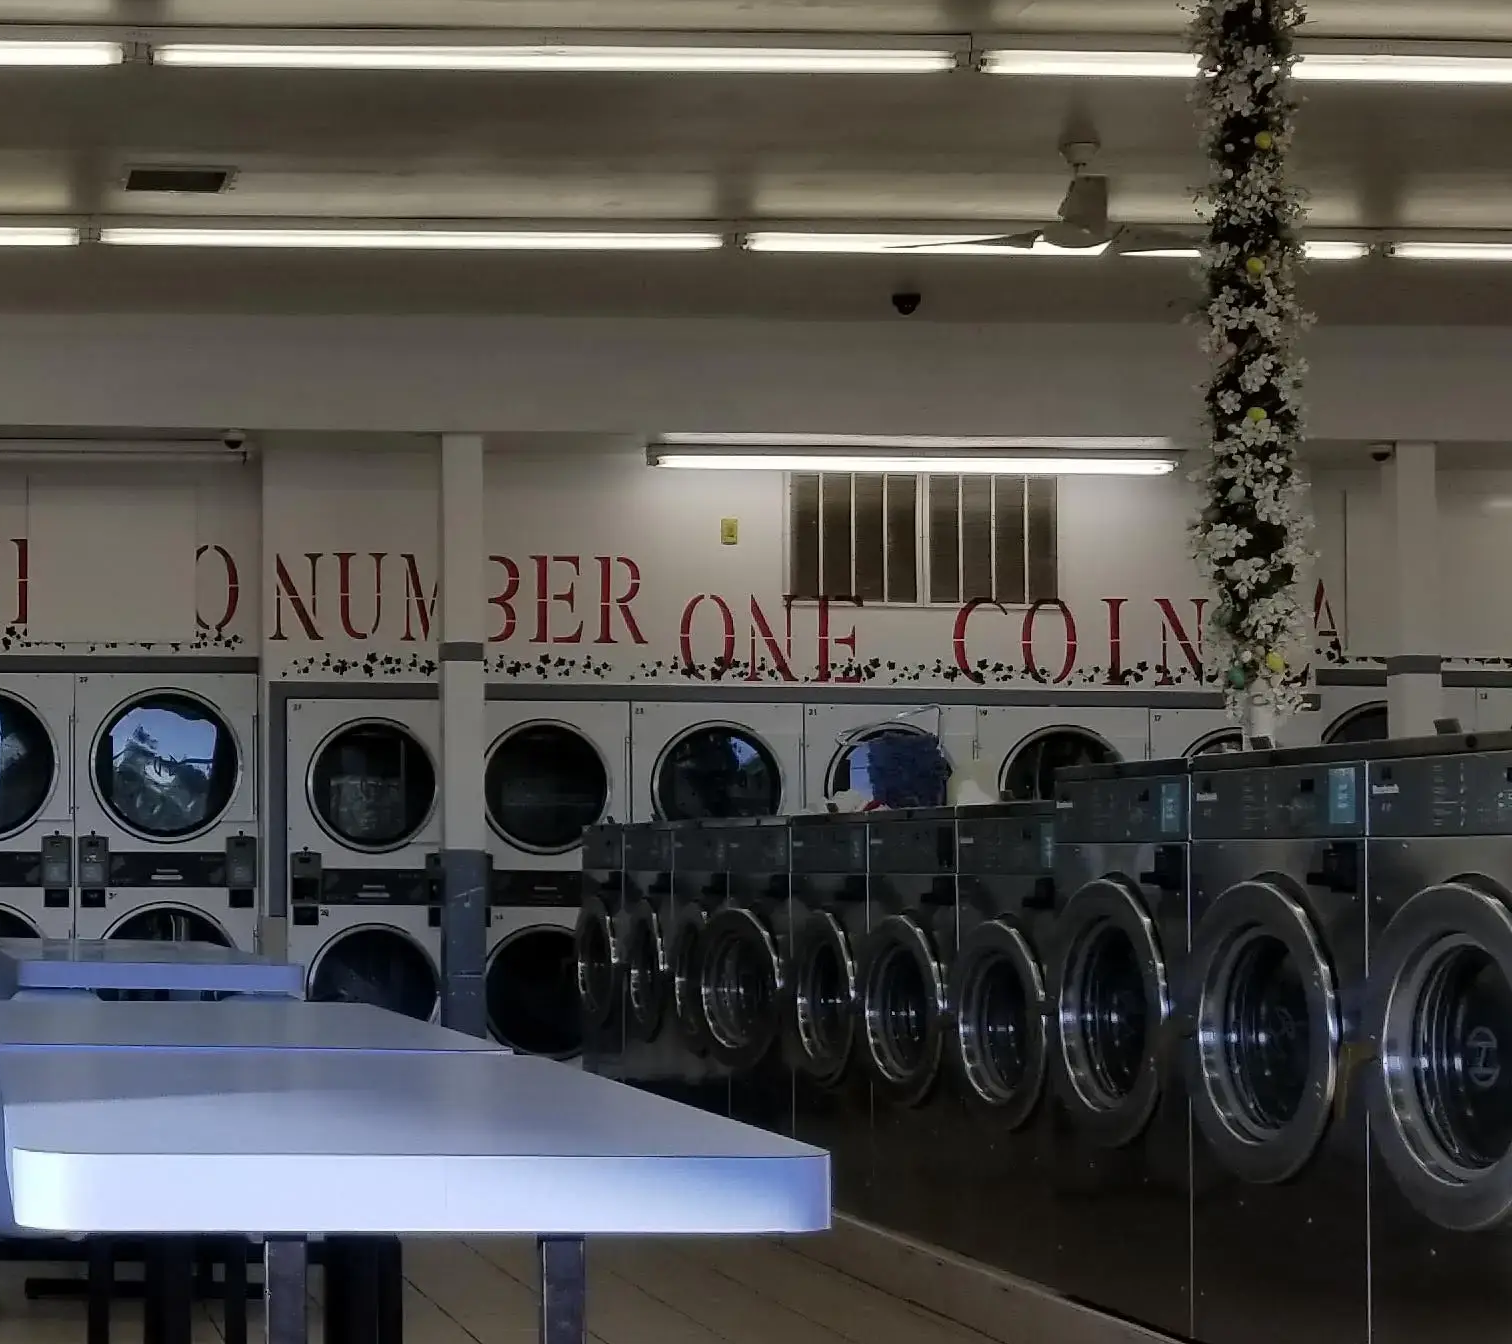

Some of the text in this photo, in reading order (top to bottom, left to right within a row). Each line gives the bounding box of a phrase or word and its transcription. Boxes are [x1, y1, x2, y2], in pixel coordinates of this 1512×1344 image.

[269, 552, 649, 643] NUMBER
[679, 594, 863, 682] ONE
[953, 597, 1209, 687] COIN
